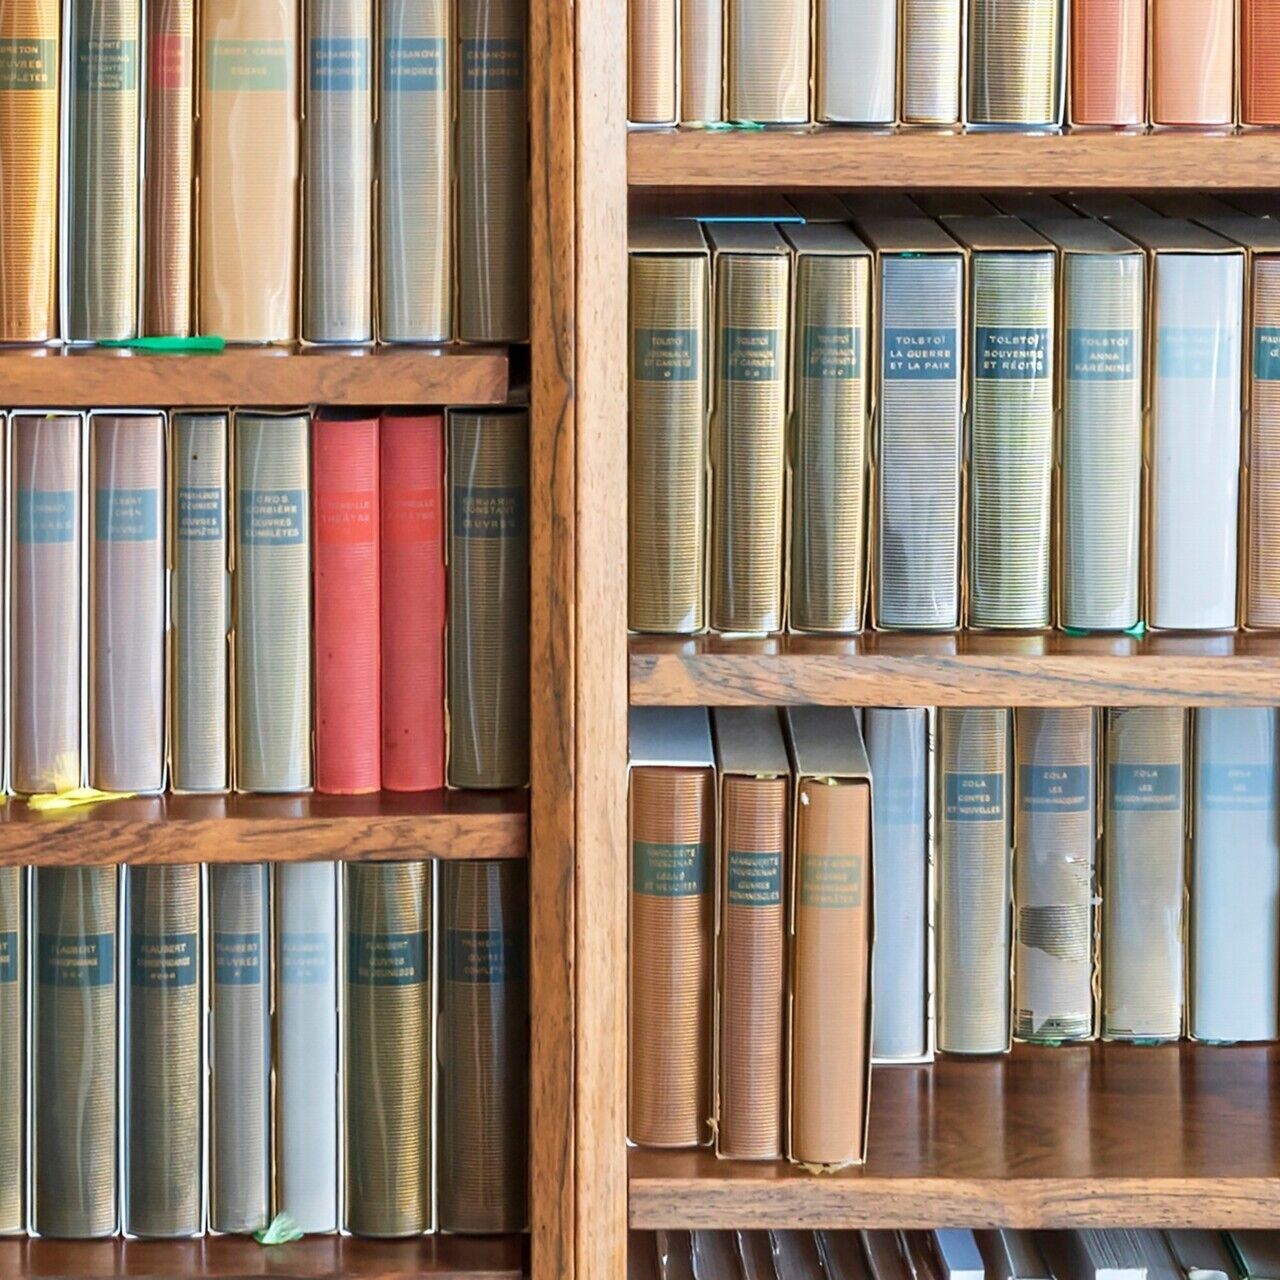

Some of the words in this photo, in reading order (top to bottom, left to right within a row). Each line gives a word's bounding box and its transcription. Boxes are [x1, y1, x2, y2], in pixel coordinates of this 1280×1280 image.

[390, 49, 440, 59] CASANOVA
[895, 335, 945, 344] TOLSTOÏ
[988, 334, 1039, 344] TOLSTOÏ
[1078, 335, 1129, 346] TOLSTOÏ
[890, 350, 903, 358] LA
[906, 350, 951, 358] GUERRE
[983, 349, 1044, 359] SOUVENIRS
[1089, 352, 1120, 361] ANNA
[890, 361, 902, 370] ET
[907, 361, 921, 370] LA
[924, 361, 950, 370] PAIX
[983, 360, 996, 370] ET
[1002, 358, 1043, 370] RÉCITS
[1043, 770, 1068, 780] ZOLA
[1133, 769, 1158, 778] ZOLA
[962, 779, 986, 788] ZOLA
